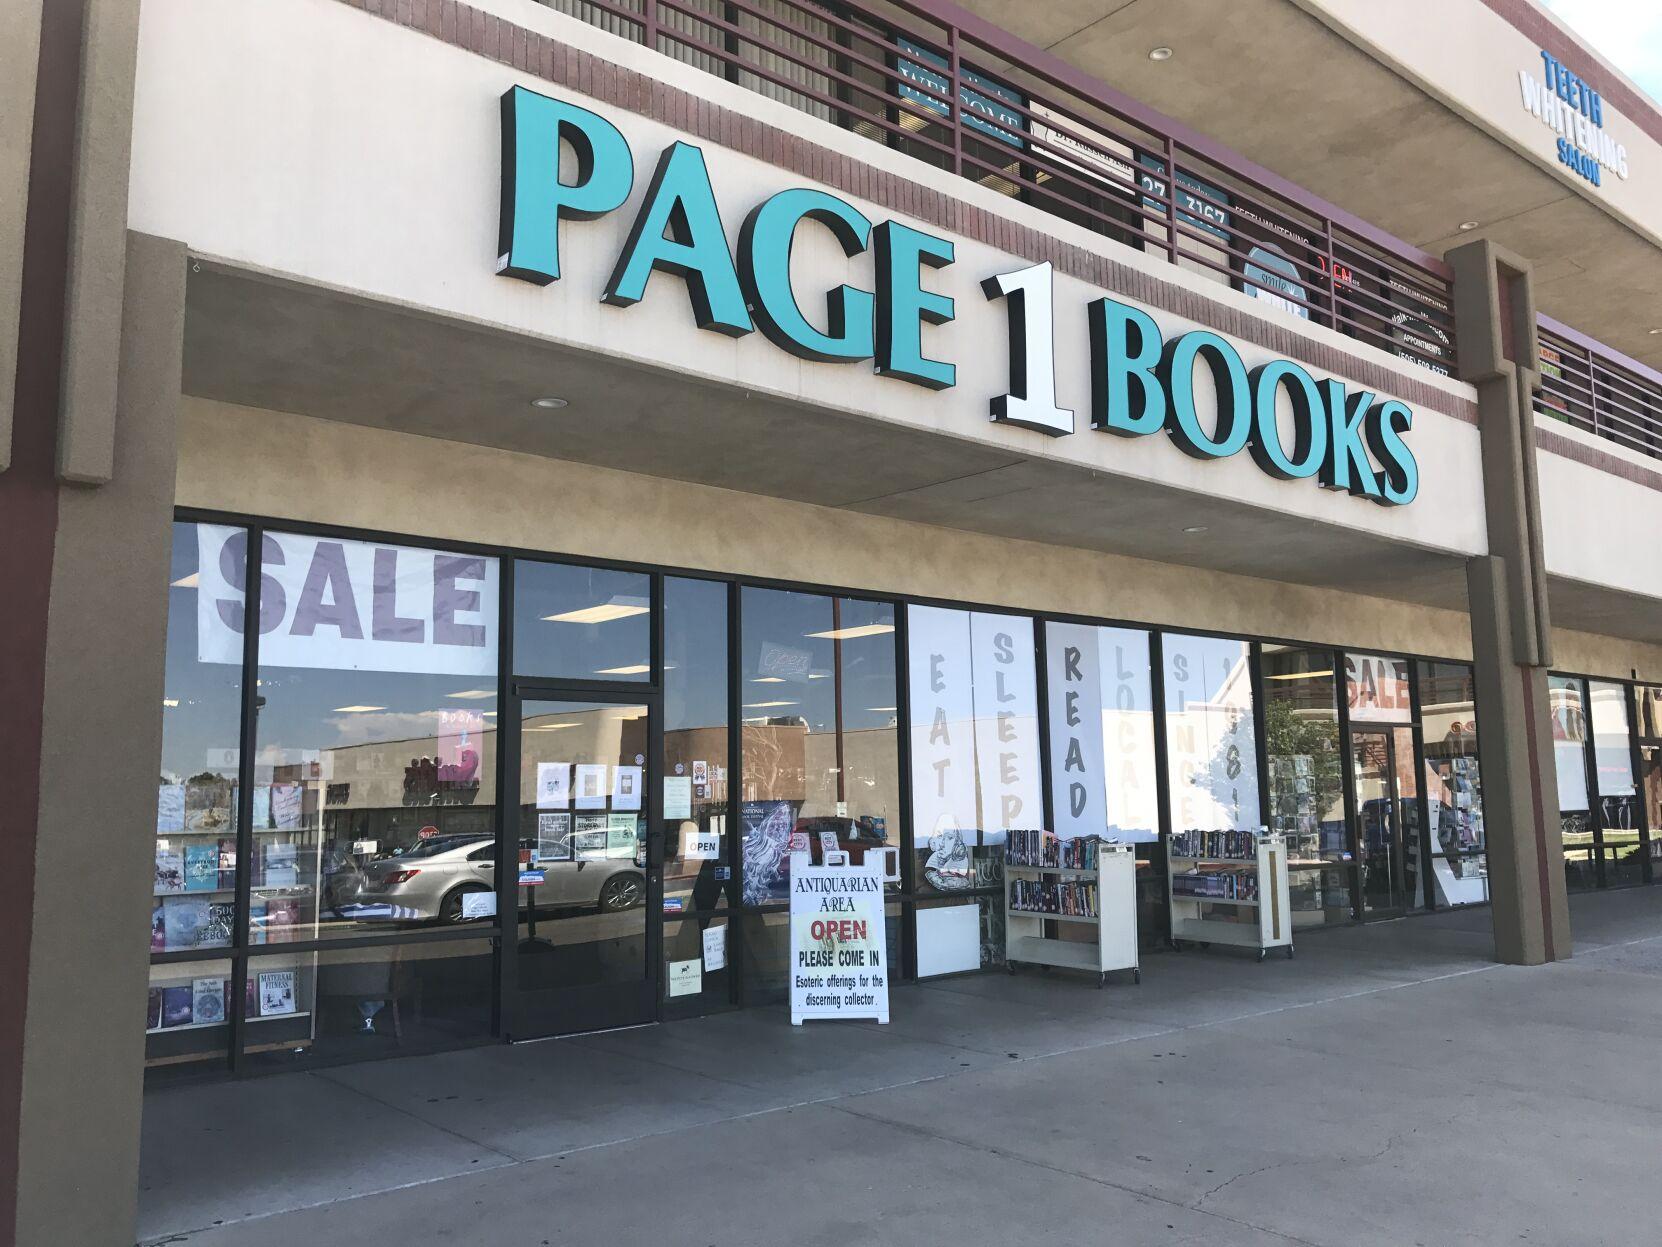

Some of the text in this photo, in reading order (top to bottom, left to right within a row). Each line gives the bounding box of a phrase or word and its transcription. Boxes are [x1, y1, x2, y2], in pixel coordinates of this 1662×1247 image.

[1541, 50, 1603, 129] TEETH
[1518, 70, 1628, 181] WHITENING
[1557, 137, 1600, 187] SALON
[496, 84, 1419, 507] PAGE 1 BOOKS
[216, 532, 487, 647] SALE
[1344, 656, 1409, 709] SALE
[930, 653, 950, 798] EAT
[994, 632, 1024, 828] SLEEP
[1064, 645, 1087, 819] READ
[1115, 645, 1142, 825] LOCAL
[1173, 653, 1196, 826] SINCE
[690, 842, 716, 851] OPEN
[795, 877, 879, 895] ANTIQUARIAN
[819, 897, 856, 912] AREA
[799, 950, 879, 967] PLEASE COME IN
[810, 920, 867, 940] OPEN
[796, 973, 883, 990] Esoteric offerings for the
[805, 992, 874, 1009] discerning collector
